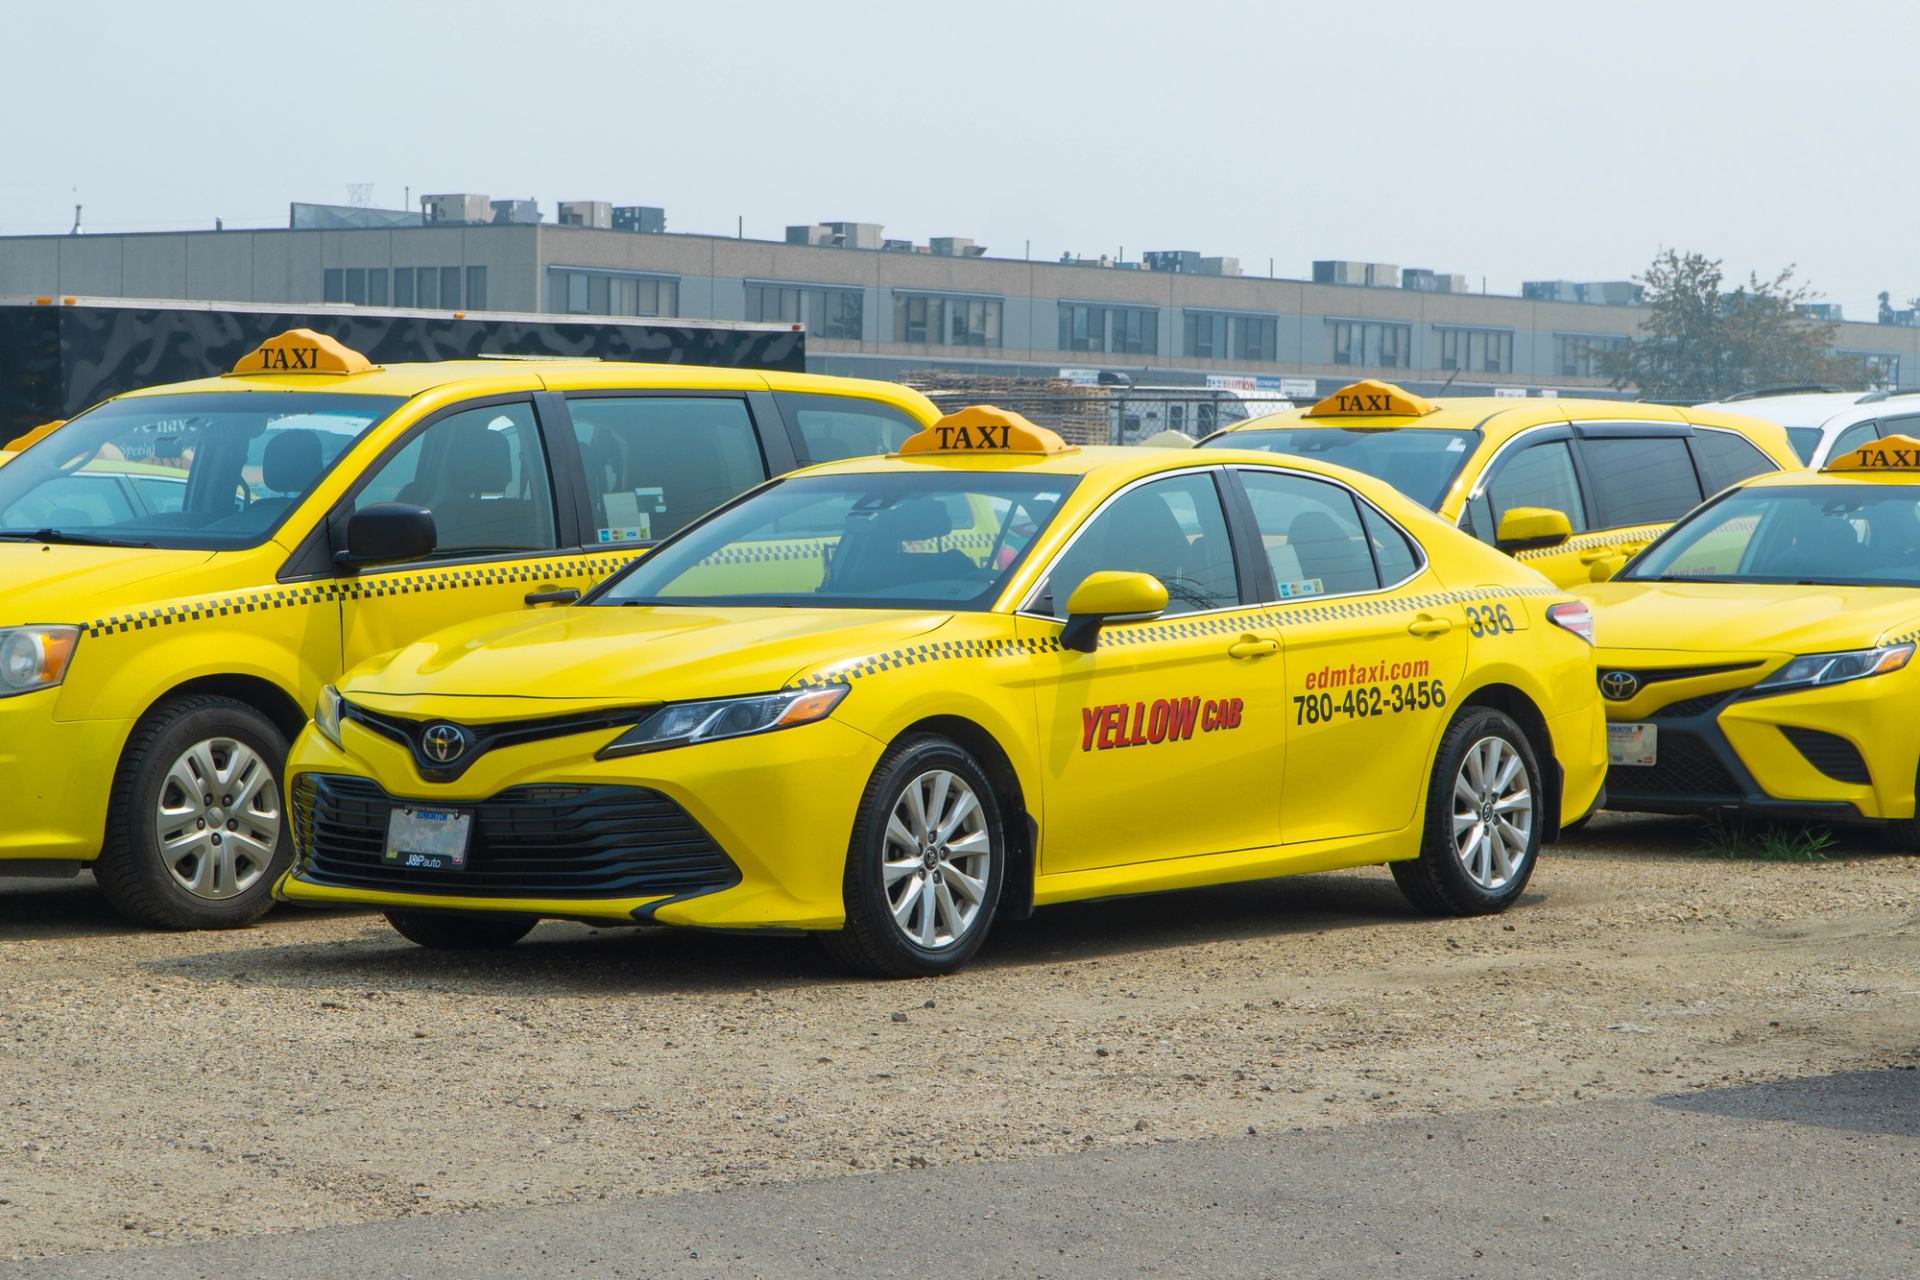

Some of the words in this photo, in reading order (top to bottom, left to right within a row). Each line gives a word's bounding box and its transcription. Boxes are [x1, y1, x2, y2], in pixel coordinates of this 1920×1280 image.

[259, 347, 318, 370] TAXI
[1337, 393, 1392, 413] TAXI
[935, 425, 1010, 450] TAXI
[1856, 449, 1920, 467] TAXI
[1465, 603, 1514, 638] 336
[1305, 659, 1429, 690] edmtaxi.com
[1293, 679, 1446, 725] 780-462-3456
[1081, 696, 1201, 752] YELLOW
[1201, 697, 1244, 733] CAB
